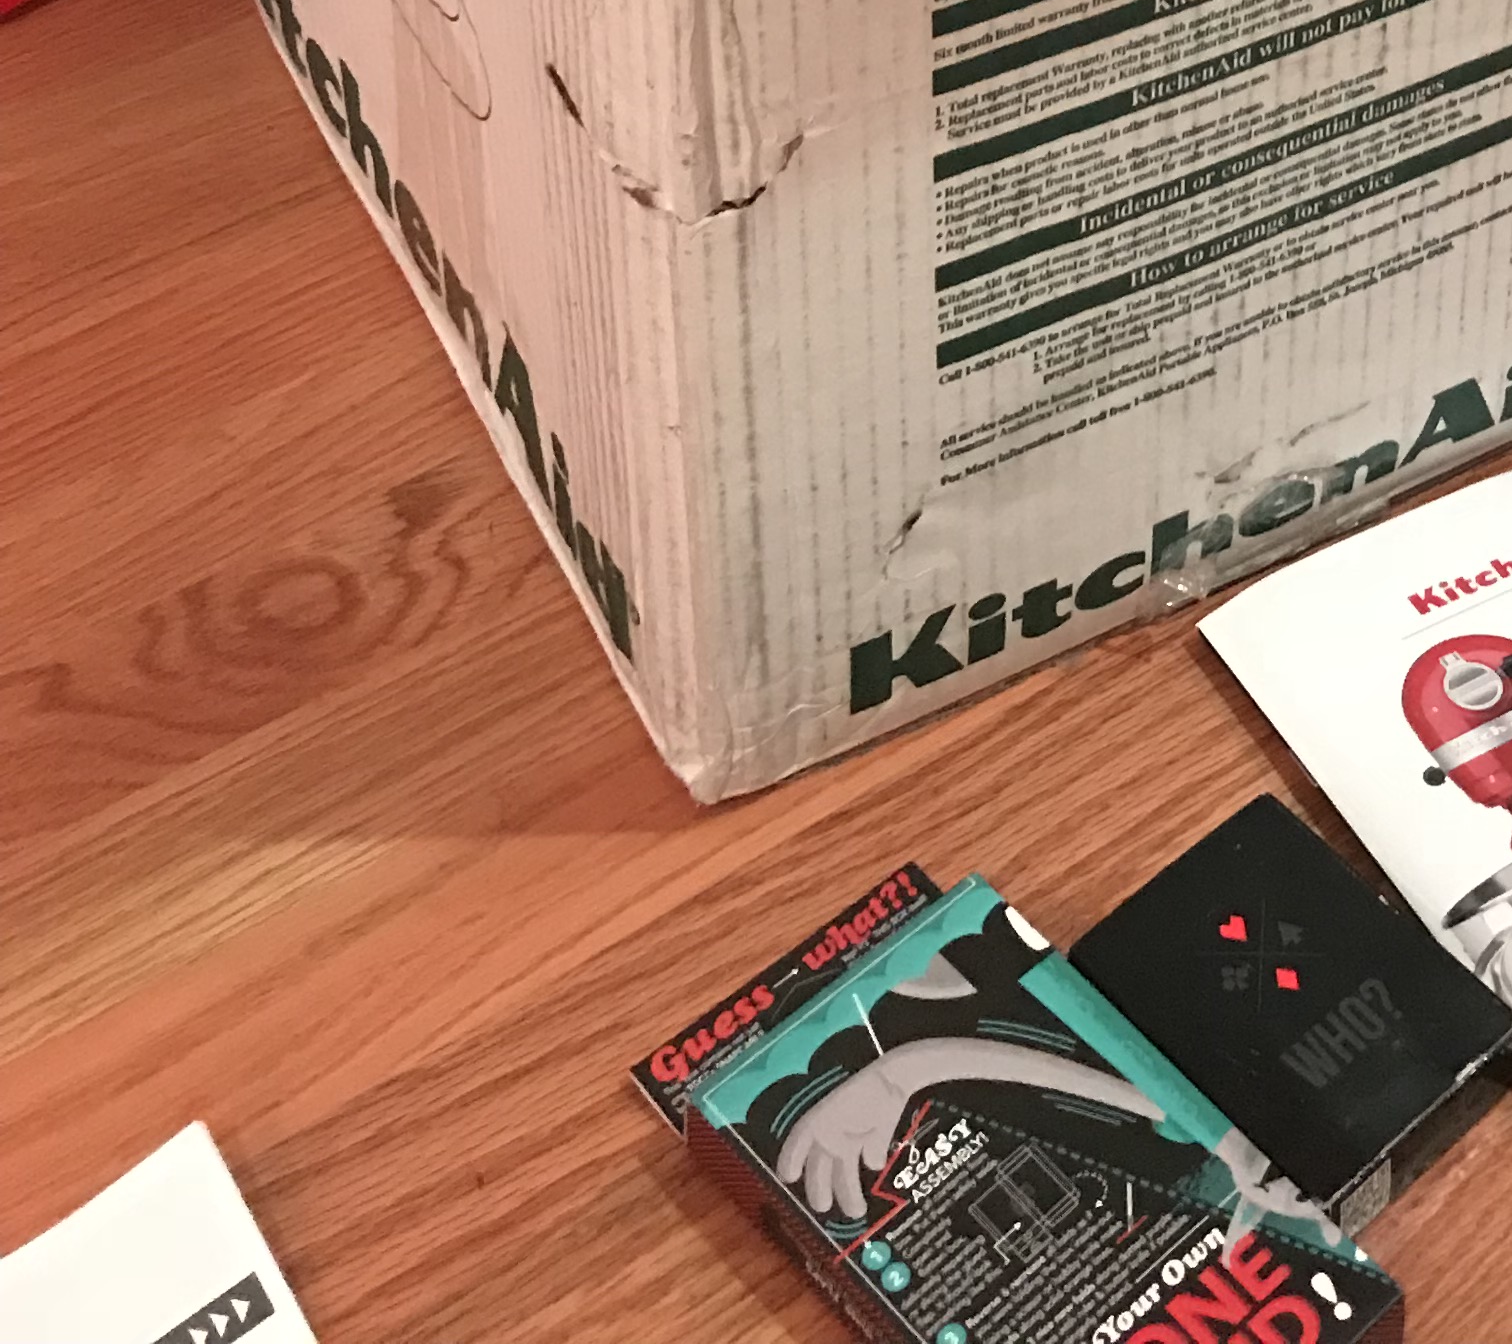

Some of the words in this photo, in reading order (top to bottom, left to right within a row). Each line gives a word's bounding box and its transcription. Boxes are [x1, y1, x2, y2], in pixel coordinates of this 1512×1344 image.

[933, 44, 952, 63] Six
[995, 15, 1034, 41] limited
[1131, 45, 1252, 108] KitchenAid
[1259, 30, 1294, 60] will
[1301, 17, 1332, 44] not
[1338, 2, 1375, 33] pay
[1079, 176, 1186, 235] Incidental
[1192, 169, 1215, 191] or
[1220, 111, 1355, 182] consequential
[1361, 76, 1445, 126] damages
[1130, 255, 1176, 289] How
[1184, 244, 1204, 267] to
[1210, 213, 1287, 260] arrange
[1294, 195, 1322, 222] for
[1328, 167, 1394, 209] service
[649, 980, 776, 1082] Guess
[802, 867, 920, 972] what?!
[1280, 978, 1404, 1089] WHO?
[892, 1119, 973, 1191] EASY
[911, 1133, 990, 1204] ASSEMBLY!
[1093, 1279, 1166, 1344] Your
[1160, 1226, 1226, 1288] Own
